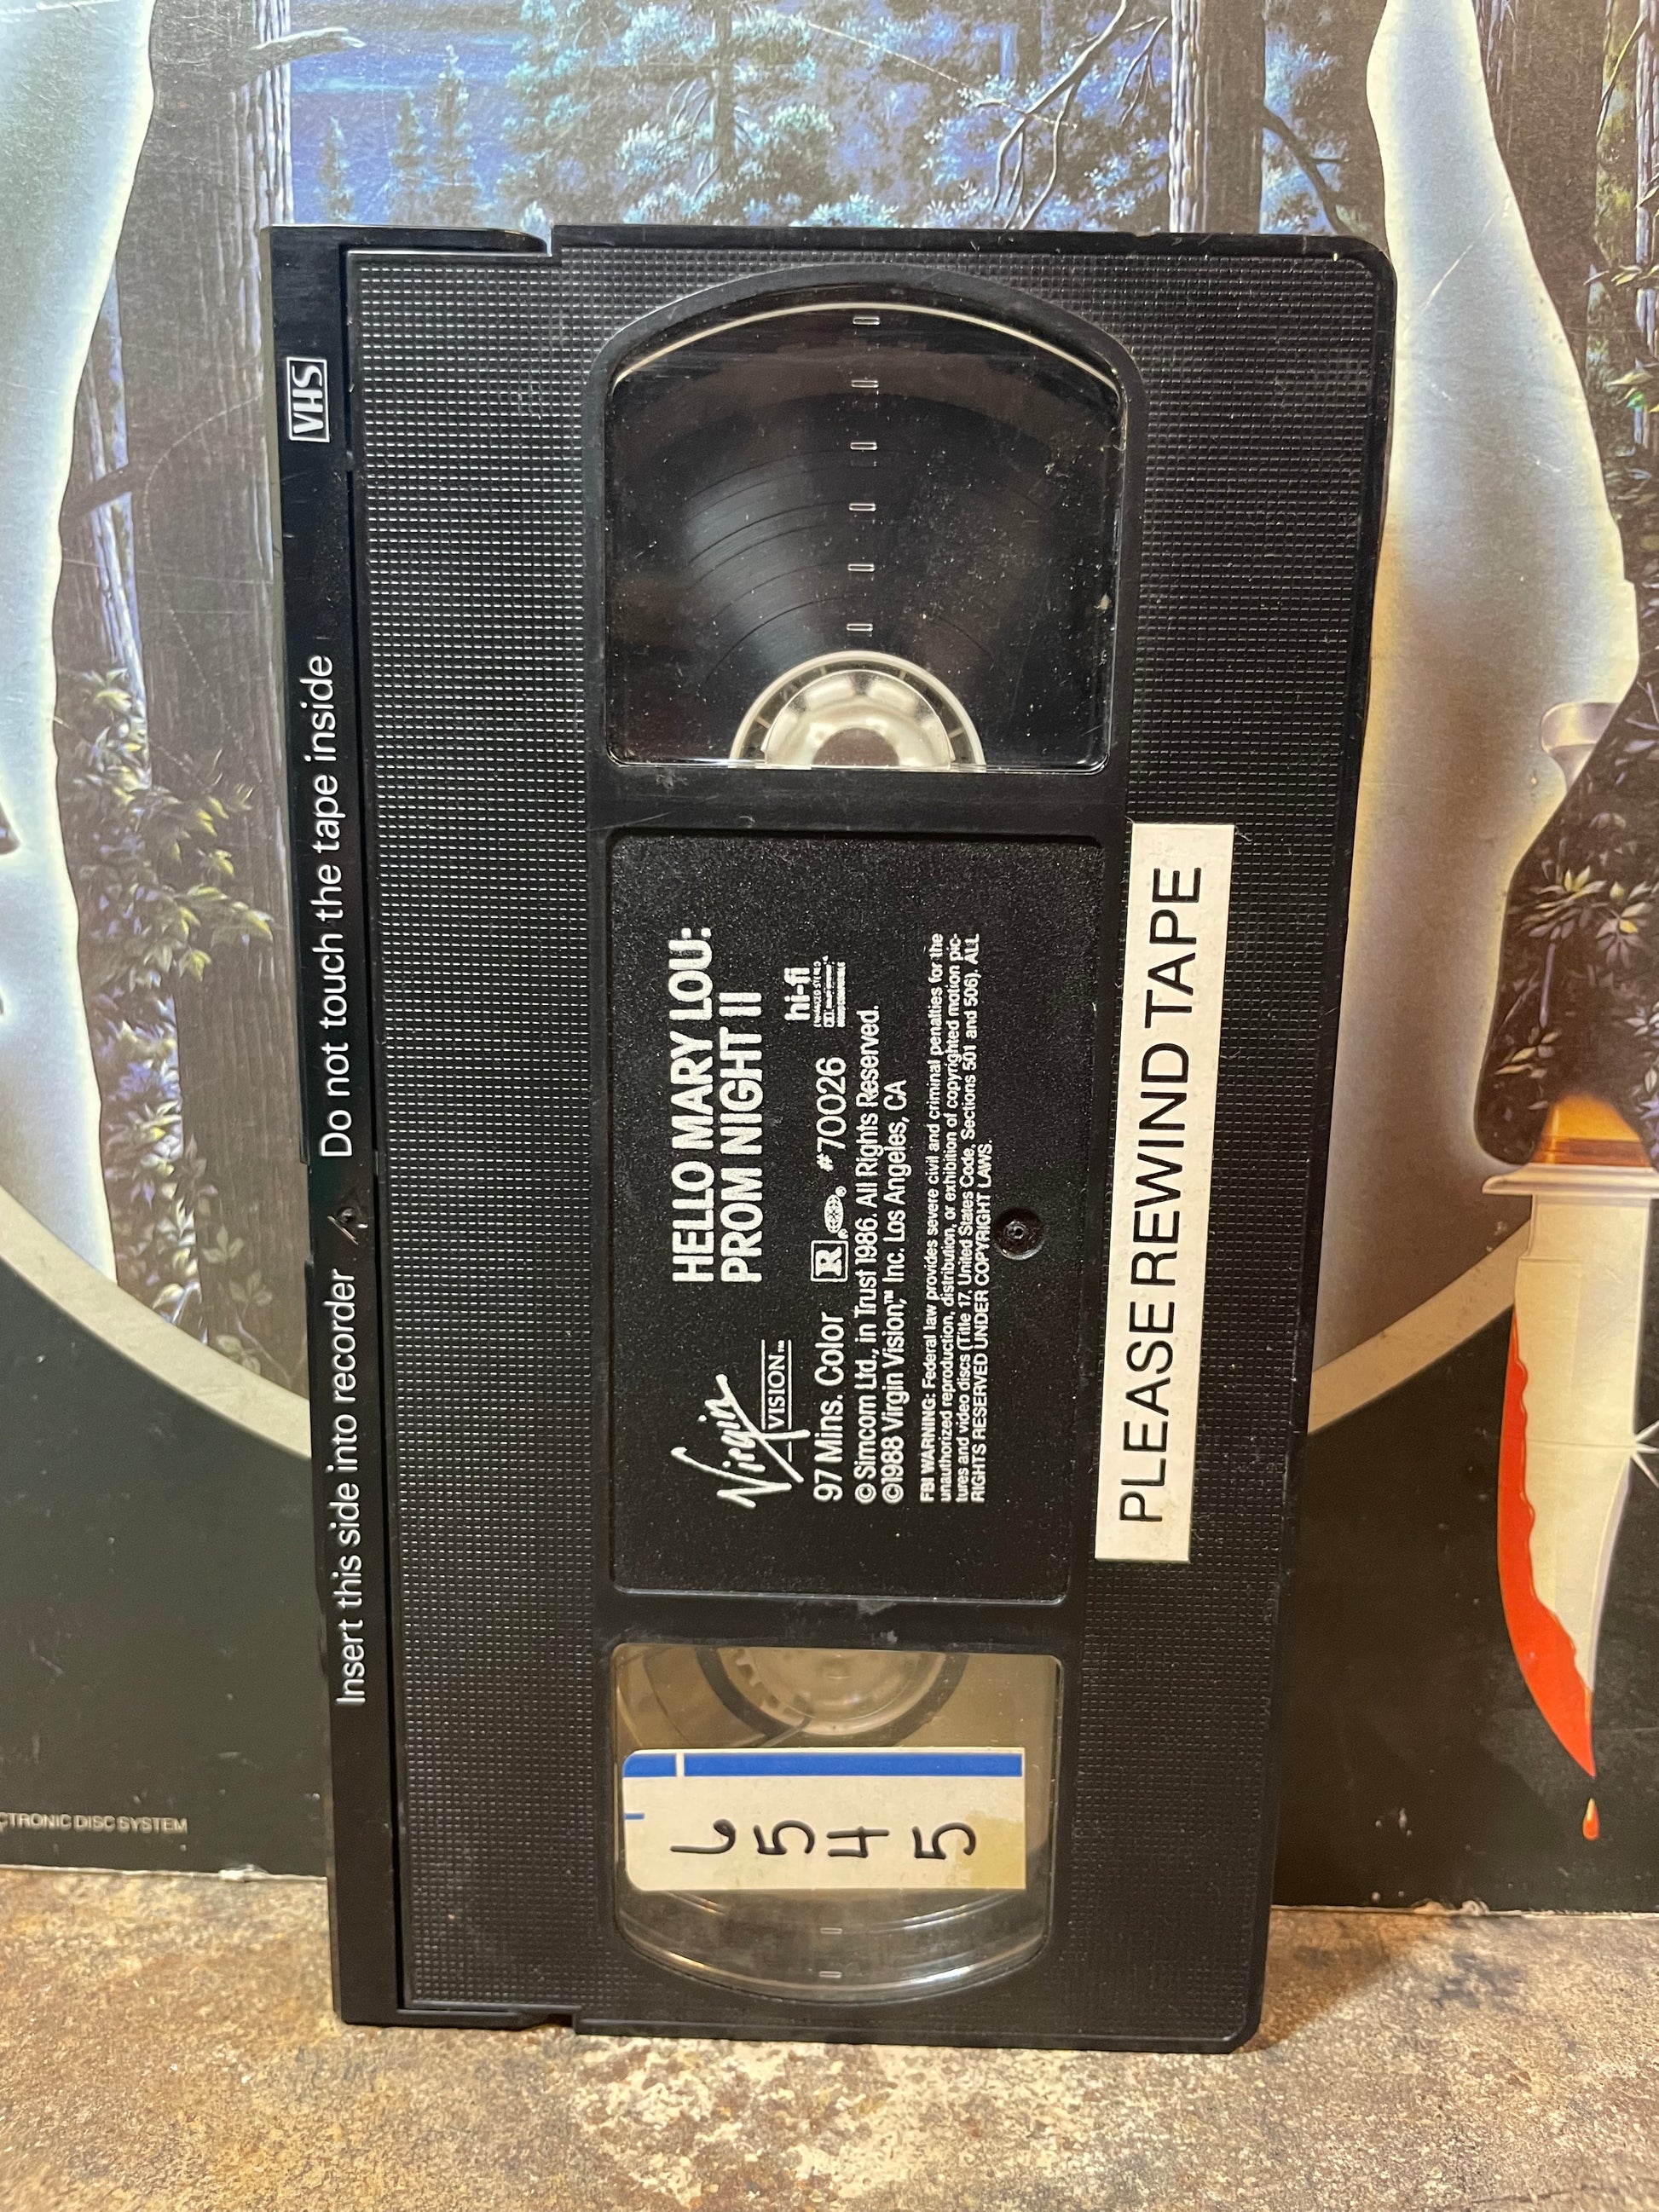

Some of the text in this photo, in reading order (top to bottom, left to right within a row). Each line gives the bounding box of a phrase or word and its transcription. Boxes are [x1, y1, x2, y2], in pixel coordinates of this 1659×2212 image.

[292, 365, 323, 432] VHS
[300, 656, 353, 1157] Do not touch the tape inside
[784, 967, 811, 1020] hi-fi
[856, 1005, 879, 1106] Reserved.
[668, 927, 714, 1281] HELLO MARY LOU:
[815, 1057, 847, 1171] #70026
[884, 1080, 907, 1110] CA
[719, 992, 764, 1281] PROM NIGHT II
[856, 1113, 884, 1176] Rights
[884, 1117, 911, 1204] Angeles,
[855, 1183, 878, 1207] All
[883, 1210, 905, 1241] Los
[921, 933, 944, 1503] FBI WARNING: Federal law provides severe civil and criminal penalties for the
[939, 933, 963, 1502] unauthorized reproduction, distribution, or exhibition of copyrighted motion pic-
[957, 933, 981, 1503] tures and video discs (Title 17, United States Code, Sections 501 and 506). ALL
[1119, 867, 1202, 1522] PLEASE REWIND TAPE
[815, 1246, 841, 1276] R
[855, 1213, 878, 1264] 1986.
[885, 1247, 905, 1282] Inc.
[854, 1269, 877, 1317] Trust
[971, 1140, 993, 1503] RIGHTS RESERVED UNDER COPYRIGHT LAWS.
[854, 1349, 879, 1389] Ltd.,
[855, 1324, 876, 1342] in
[813, 1311, 844, 1501] 97 Mins. Color
[854, 1395, 876, 1479] Simcom
[882, 1373, 910, 1430] Virgin
[671, 1373, 810, 1508] Virgin
[324, 1268, 366, 1707] Insert this side into recorder
[73, 1815, 116, 1832] DISC
[117, 1816, 188, 1833] SYSTEM
[670, 1818, 977, 1859] 6545
